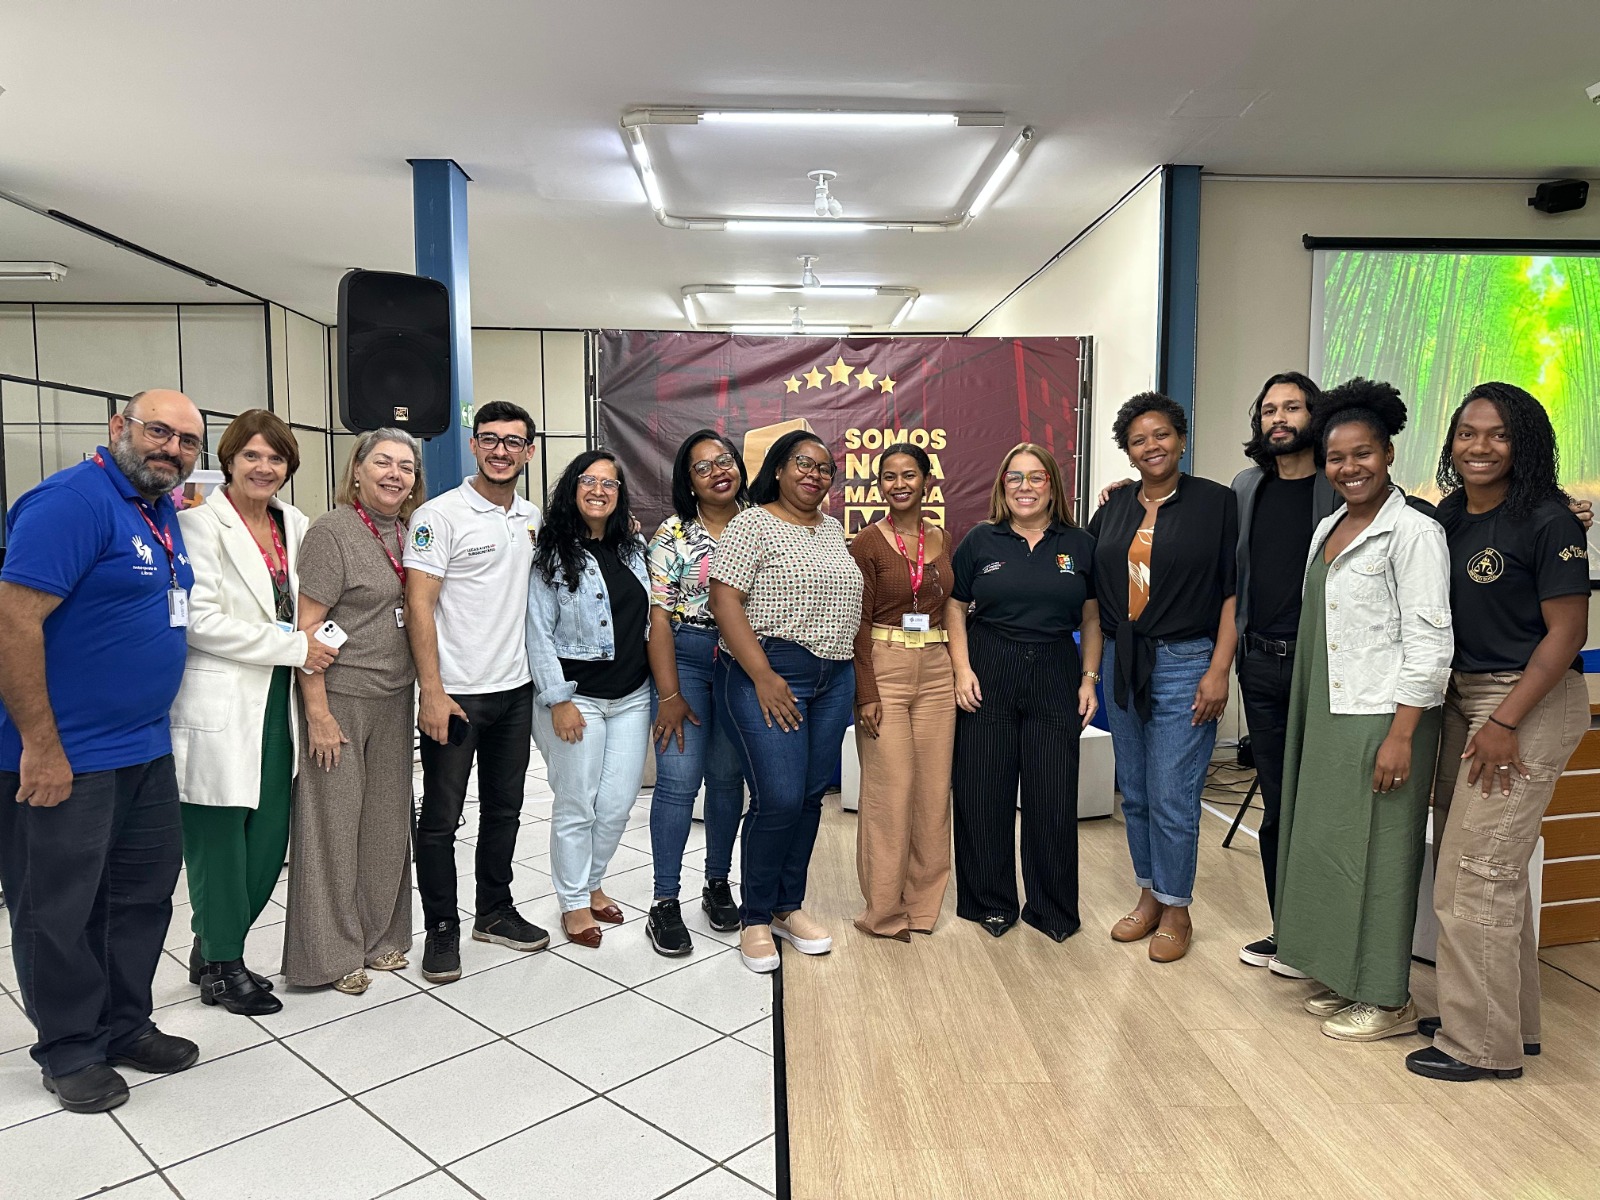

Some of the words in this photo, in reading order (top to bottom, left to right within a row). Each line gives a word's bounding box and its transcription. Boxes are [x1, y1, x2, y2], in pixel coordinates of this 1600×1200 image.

[844, 428, 947, 450] SOMOS
[845, 453, 945, 479] NA
[844, 480, 945, 503] MÁA
